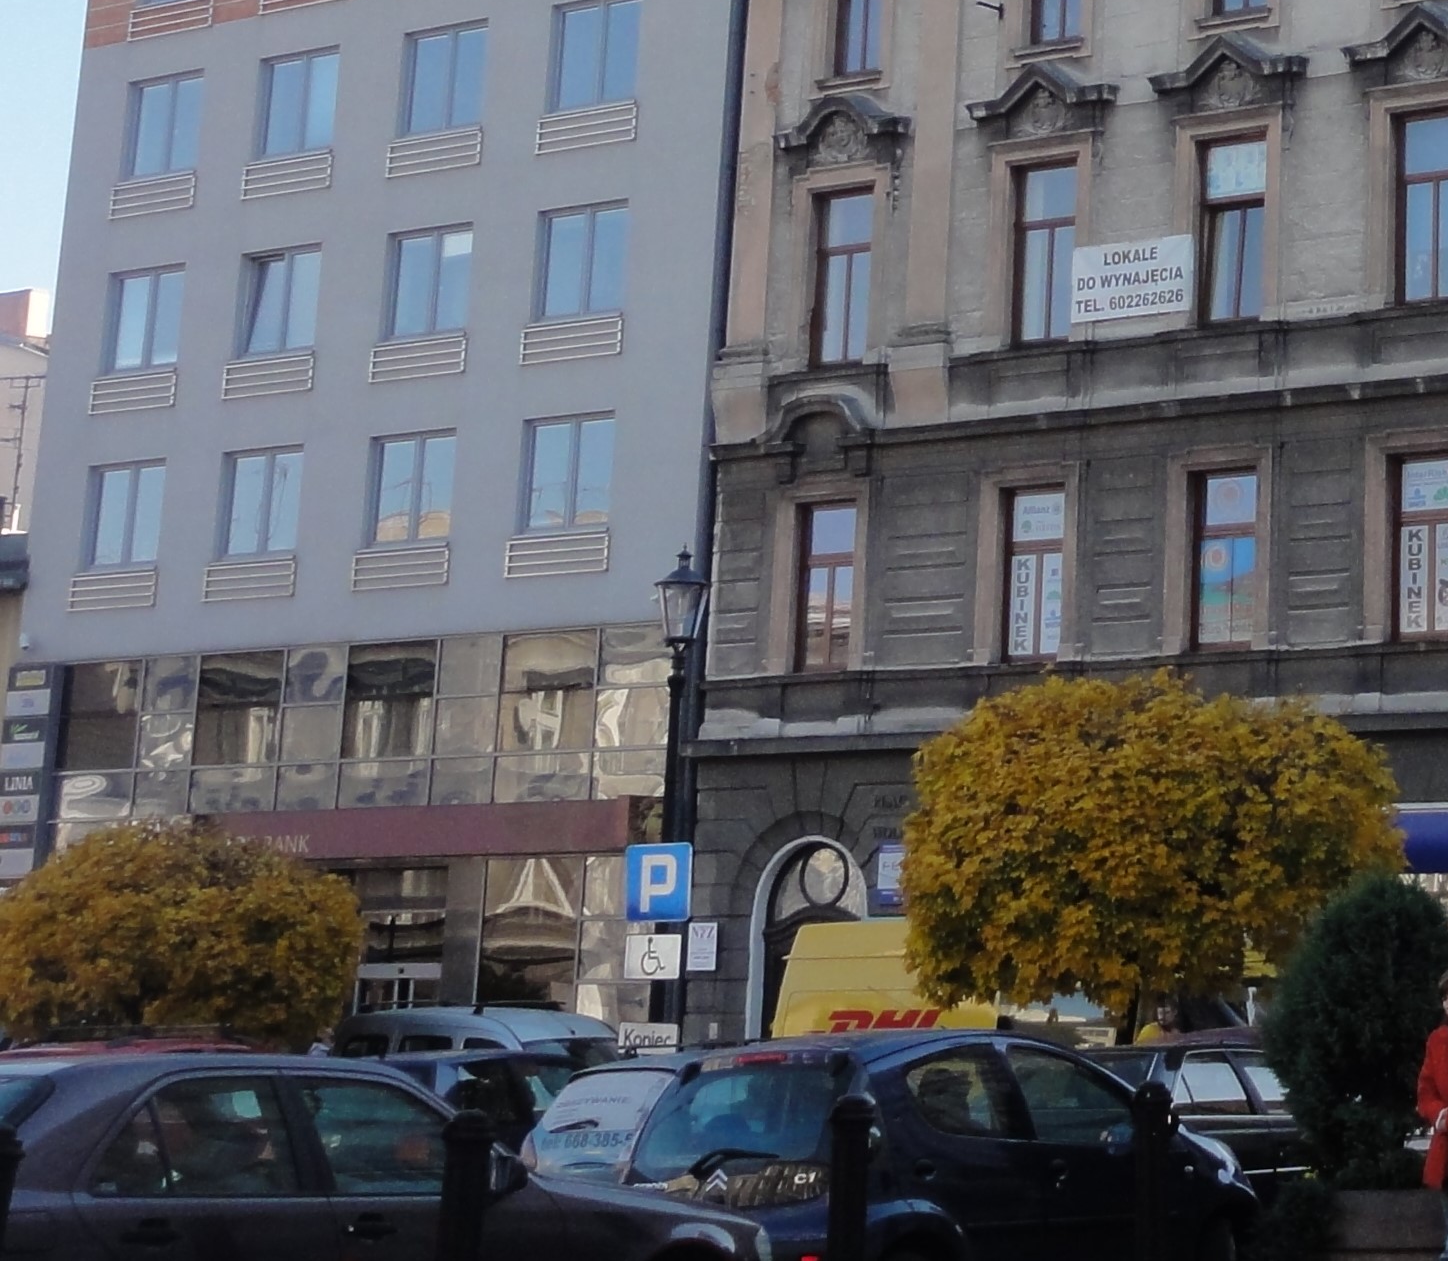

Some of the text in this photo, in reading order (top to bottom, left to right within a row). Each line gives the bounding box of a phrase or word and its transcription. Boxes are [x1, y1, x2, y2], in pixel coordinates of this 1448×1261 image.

[1103, 246, 1158, 266] LOKALE
[1077, 265, 1184, 292] DO WYNAJĘCIA
[1075, 288, 1184, 314] TEL. 602262626
[1407, 528, 1423, 628] KUBINEK
[1014, 558, 1031, 652] KUBINEK
[4, 775, 34, 791] LINIA
[640, 854, 678, 913] P
[623, 1027, 672, 1047] Koniec
[793, 1171, 817, 1185] C1
